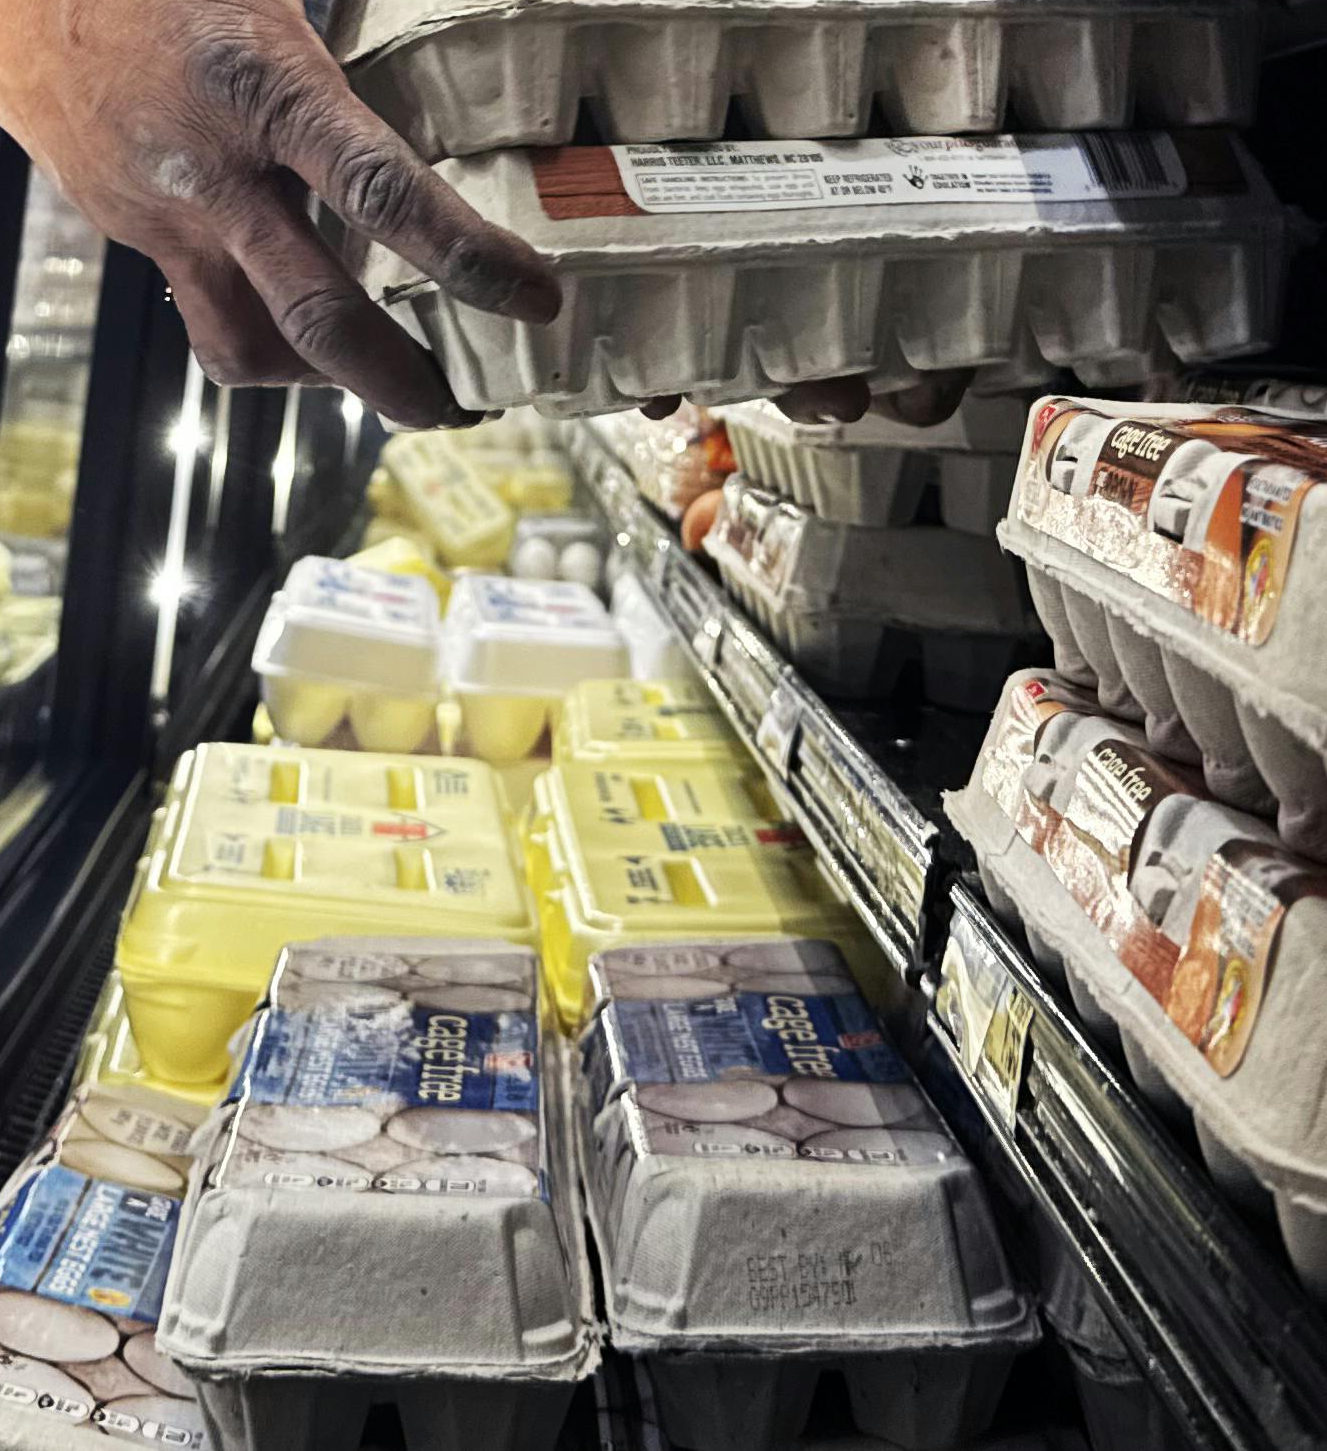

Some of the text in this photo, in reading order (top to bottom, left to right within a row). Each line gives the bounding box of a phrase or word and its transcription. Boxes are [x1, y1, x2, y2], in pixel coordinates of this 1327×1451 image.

[631, 156, 666, 167] HARRIS
[824, 173, 893, 184] KEEP REFRIGERATED
[830, 186, 839, 196] AT
[840, 186, 850, 195] OR
[852, 185, 876, 196] BELOW
[933, 181, 972, 190] EDUCATION
[1110, 425, 1172, 461] cage free
[1096, 747, 1152, 803] cage free
[762, 996, 841, 1078] cage free
[412, 1014, 481, 1102] cage free
[80, 1183, 123, 1230] LARGE
[49, 1257, 88, 1297] EGGS
[746, 1254, 787, 1283] BEST
[798, 1252, 827, 1279] BY:
